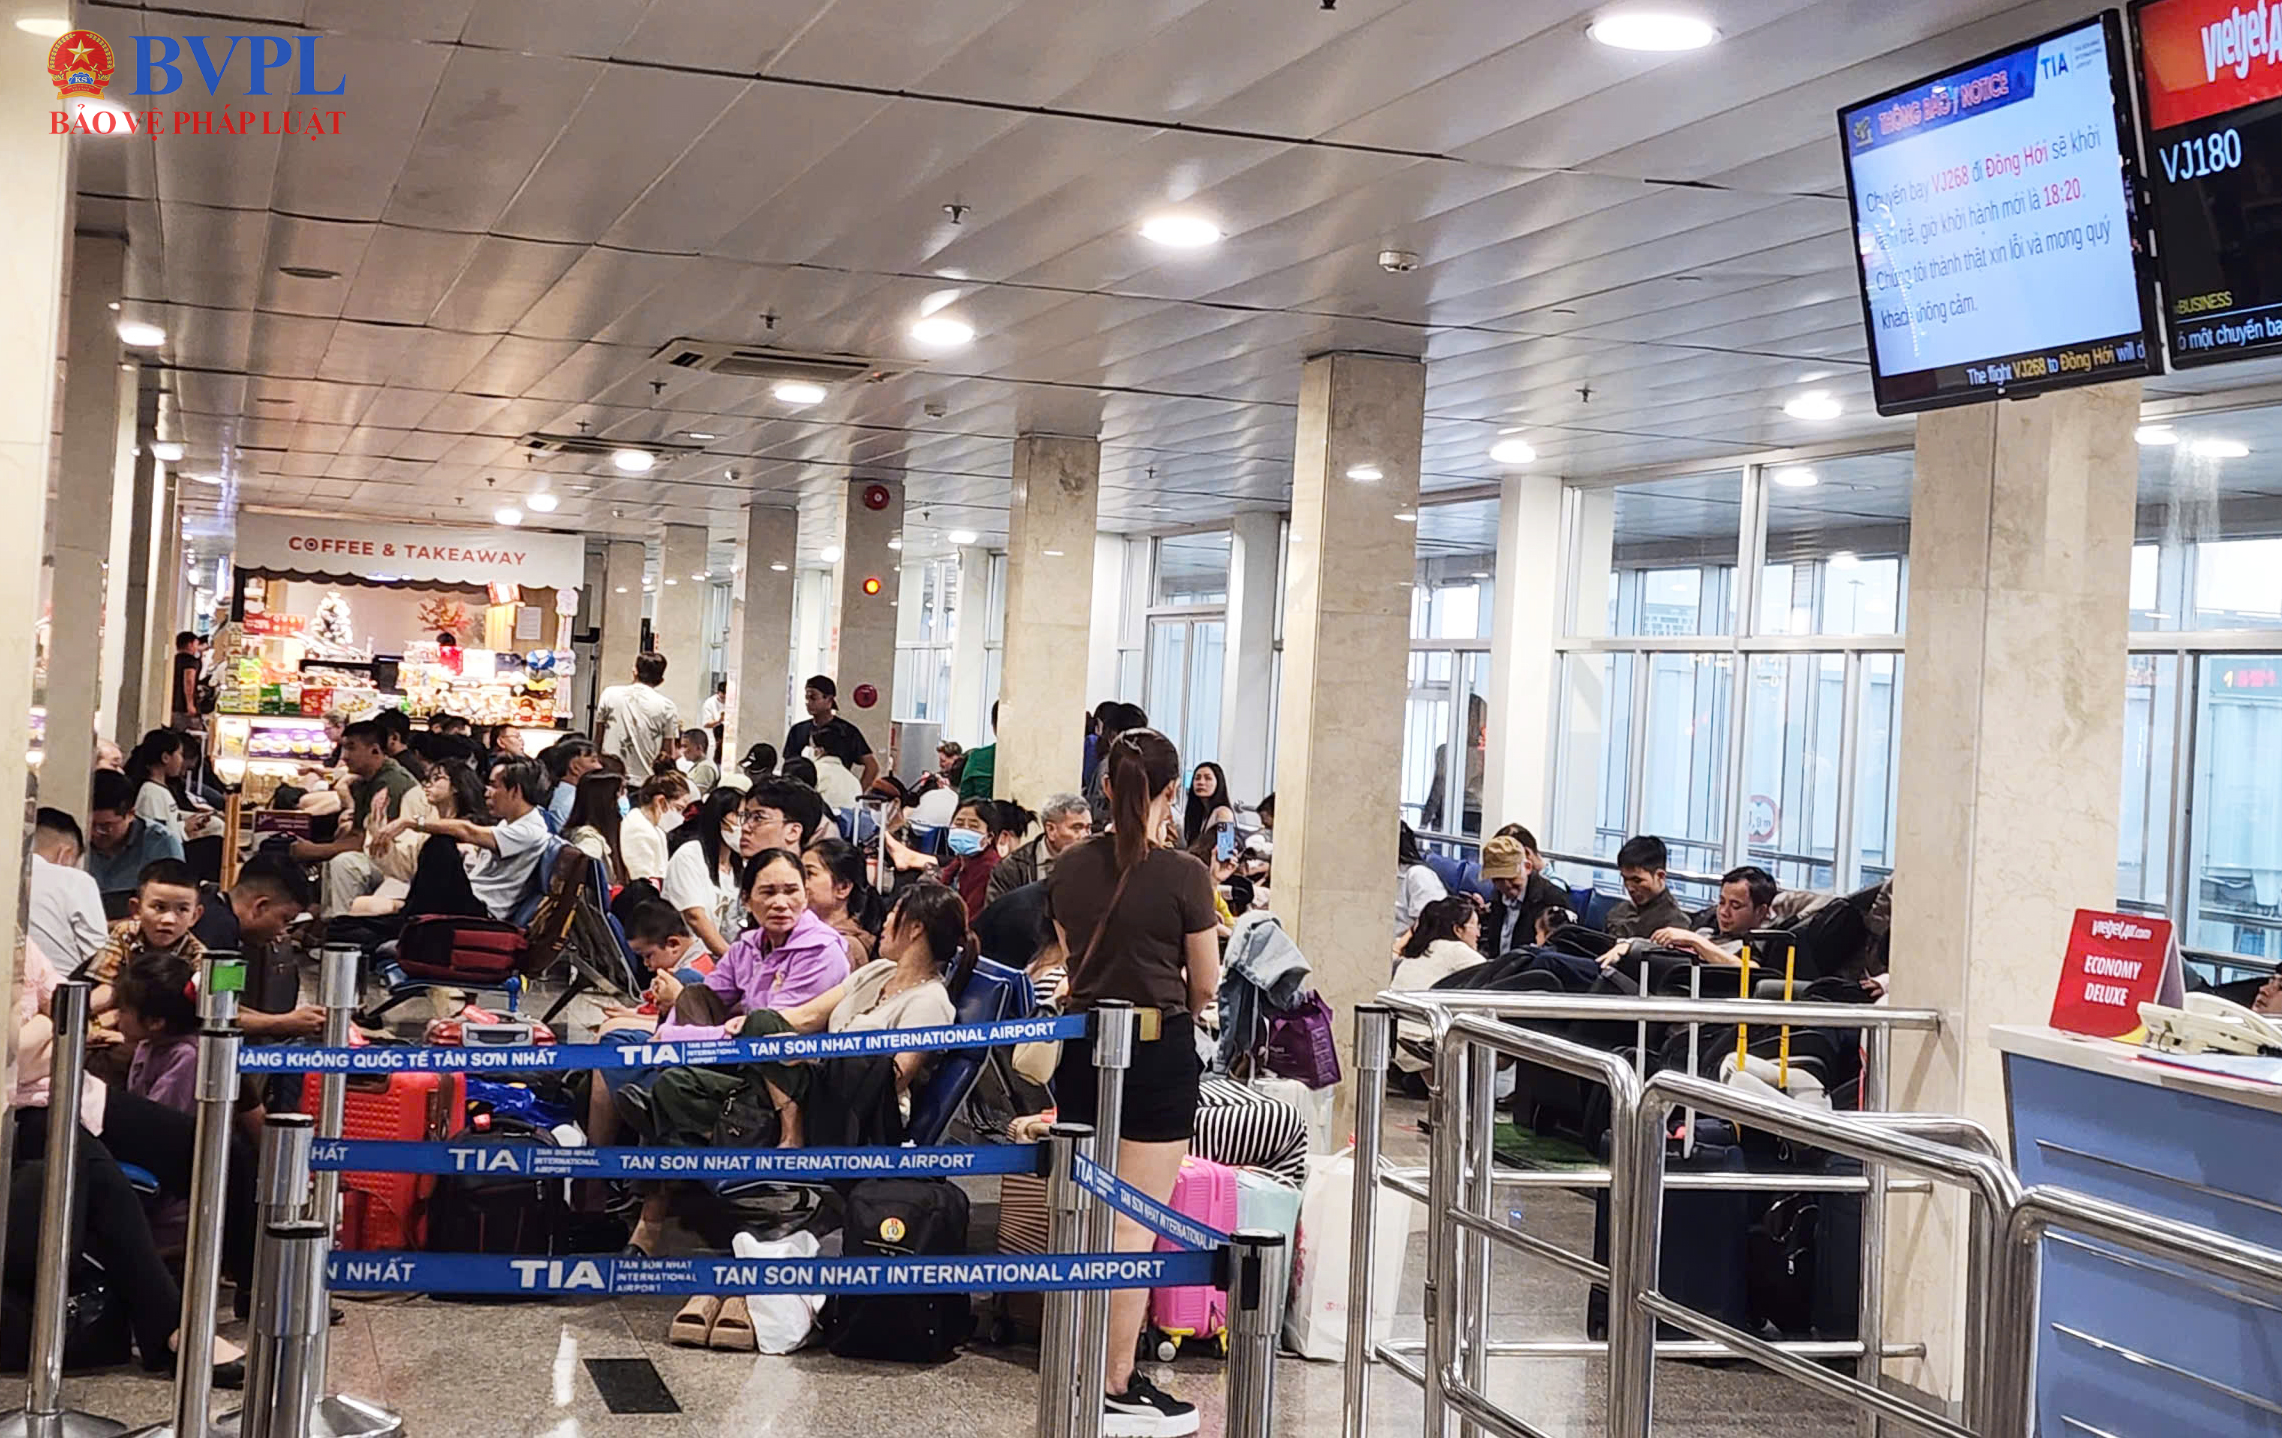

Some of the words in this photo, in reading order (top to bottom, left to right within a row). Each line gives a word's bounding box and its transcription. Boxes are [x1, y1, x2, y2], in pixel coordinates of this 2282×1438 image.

[2040, 52, 2069, 79] TIA
[1961, 70, 2010, 108] NOTICE
[1931, 165, 1970, 193] VJ268
[1985, 153, 2021, 178] Đồng
[2051, 135, 2067, 160] sẽ
[2069, 125, 2101, 153] khởi
[2159, 129, 2242, 183] VJ180
[1969, 201, 1999, 227] hành
[2002, 191, 2026, 218] mới
[2027, 187, 2041, 211] là
[1929, 253, 1962, 279] thành
[1963, 247, 1988, 271] thật
[1989, 242, 2008, 264] xin
[2026, 231, 2044, 256] và
[2045, 227, 2083, 252] mong
[2087, 214, 2111, 245] quý
[2176, 290, 2233, 315] BUSINESS
[2188, 327, 2215, 351] một
[2216, 317, 2264, 347] chuyến
[1966, 368, 1987, 386] The
[1988, 363, 2013, 386] flight
[2013, 357, 2047, 378] VJ268
[2047, 357, 2059, 373] to
[288, 536, 374, 556] COFFEE
[382, 543, 396, 557] &
[404, 544, 527, 566] TAKEAWAY
[2084, 954, 2143, 981] ECONOMY
[2084, 982, 2130, 1007] DELUXE
[749, 1041, 780, 1057] TAN
[783, 1038, 818, 1055] SON
[821, 1036, 863, 1053] NHAT
[865, 1028, 987, 1050] INTERNATIONAL
[989, 1020, 1057, 1041] AIRPORT
[286, 1049, 350, 1068] KHÔNG
[353, 1049, 404, 1068] QUỐC
[408, 1048, 429, 1067] TẾ
[432, 1049, 468, 1067] TÂN
[470, 1051, 509, 1067] SƠN
[511, 1048, 558, 1066] NHẤT
[616, 1043, 681, 1066] TIA
[448, 1148, 520, 1172] TIA
[619, 1154, 651, 1171] TAN
[659, 1154, 698, 1171] SON
[703, 1154, 749, 1171] NHAT
[755, 1154, 894, 1171] INTERNATIONAL
[899, 1153, 975, 1169] AIRPORT
[1074, 1154, 1094, 1187] TIA
[346, 1256, 416, 1283] NHẤT
[510, 1259, 605, 1290] TIA
[616, 1272, 698, 1282] INTERNATIONAL
[618, 1260, 639, 1269] TAN
[641, 1260, 664, 1269] SON
[665, 1260, 693, 1269] NHAT
[712, 1264, 760, 1286] TAN
[763, 1264, 813, 1286] SON
[820, 1265, 881, 1286] NHAT
[886, 1262, 1063, 1285] INTERNATIONAL
[1068, 1260, 1165, 1282] AIRPORT
[616, 1283, 662, 1293] AIRPORT
